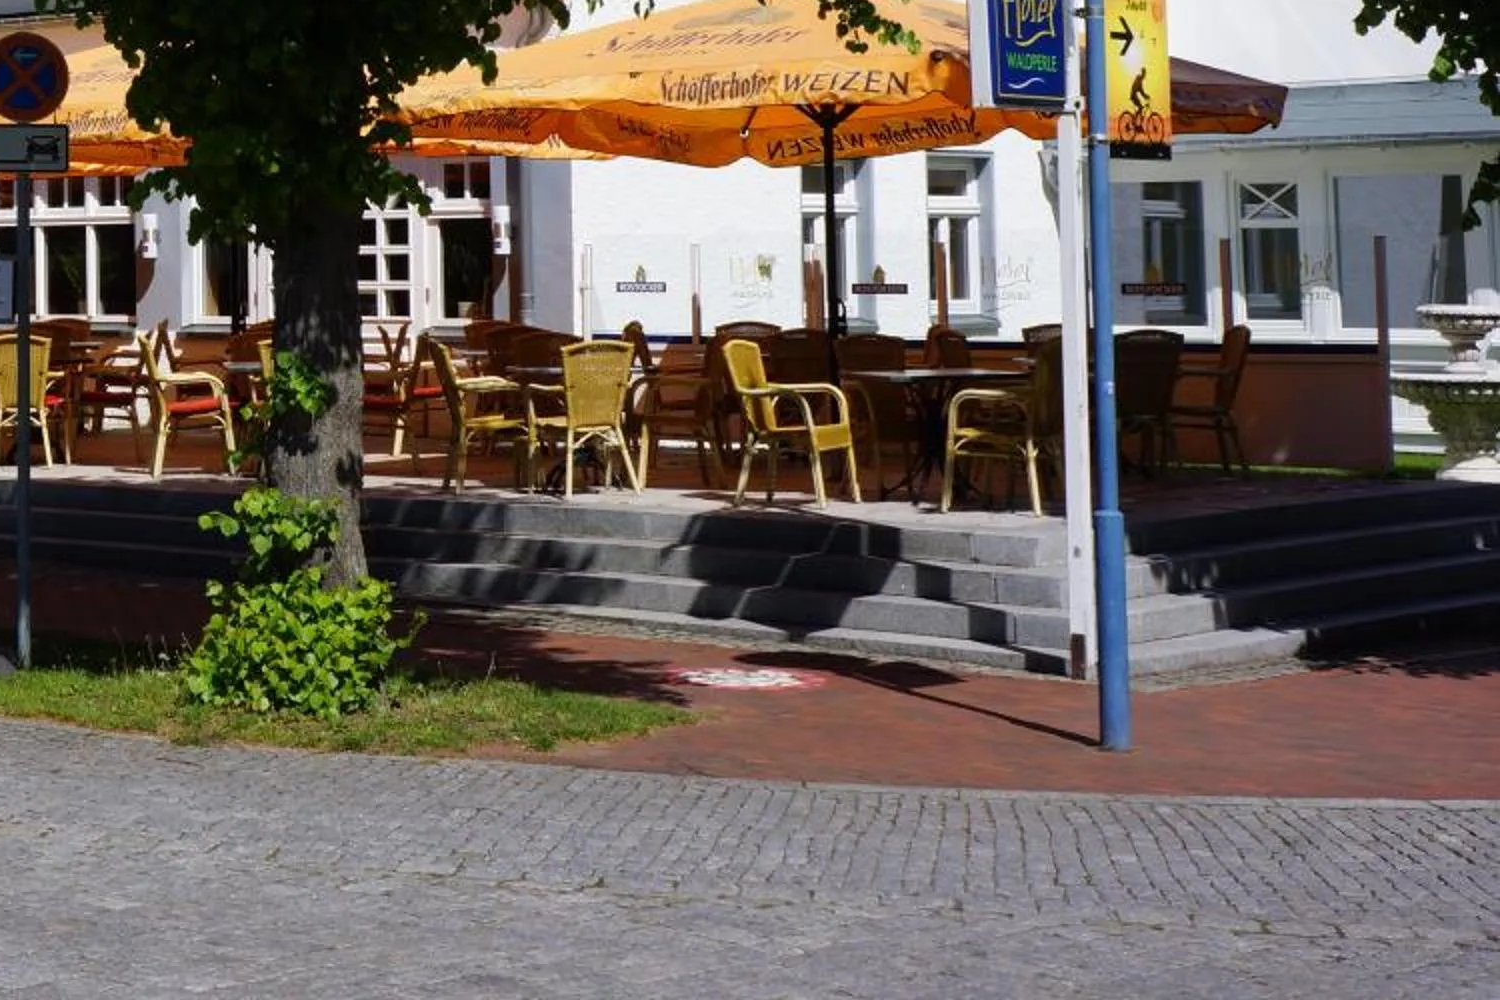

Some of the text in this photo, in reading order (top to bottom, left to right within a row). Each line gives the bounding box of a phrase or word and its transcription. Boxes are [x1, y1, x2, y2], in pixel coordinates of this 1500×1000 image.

[1006, 51, 1059, 72] WALDPERLE
[660, 69, 910, 104] Schöfferhofer WEIZEN
